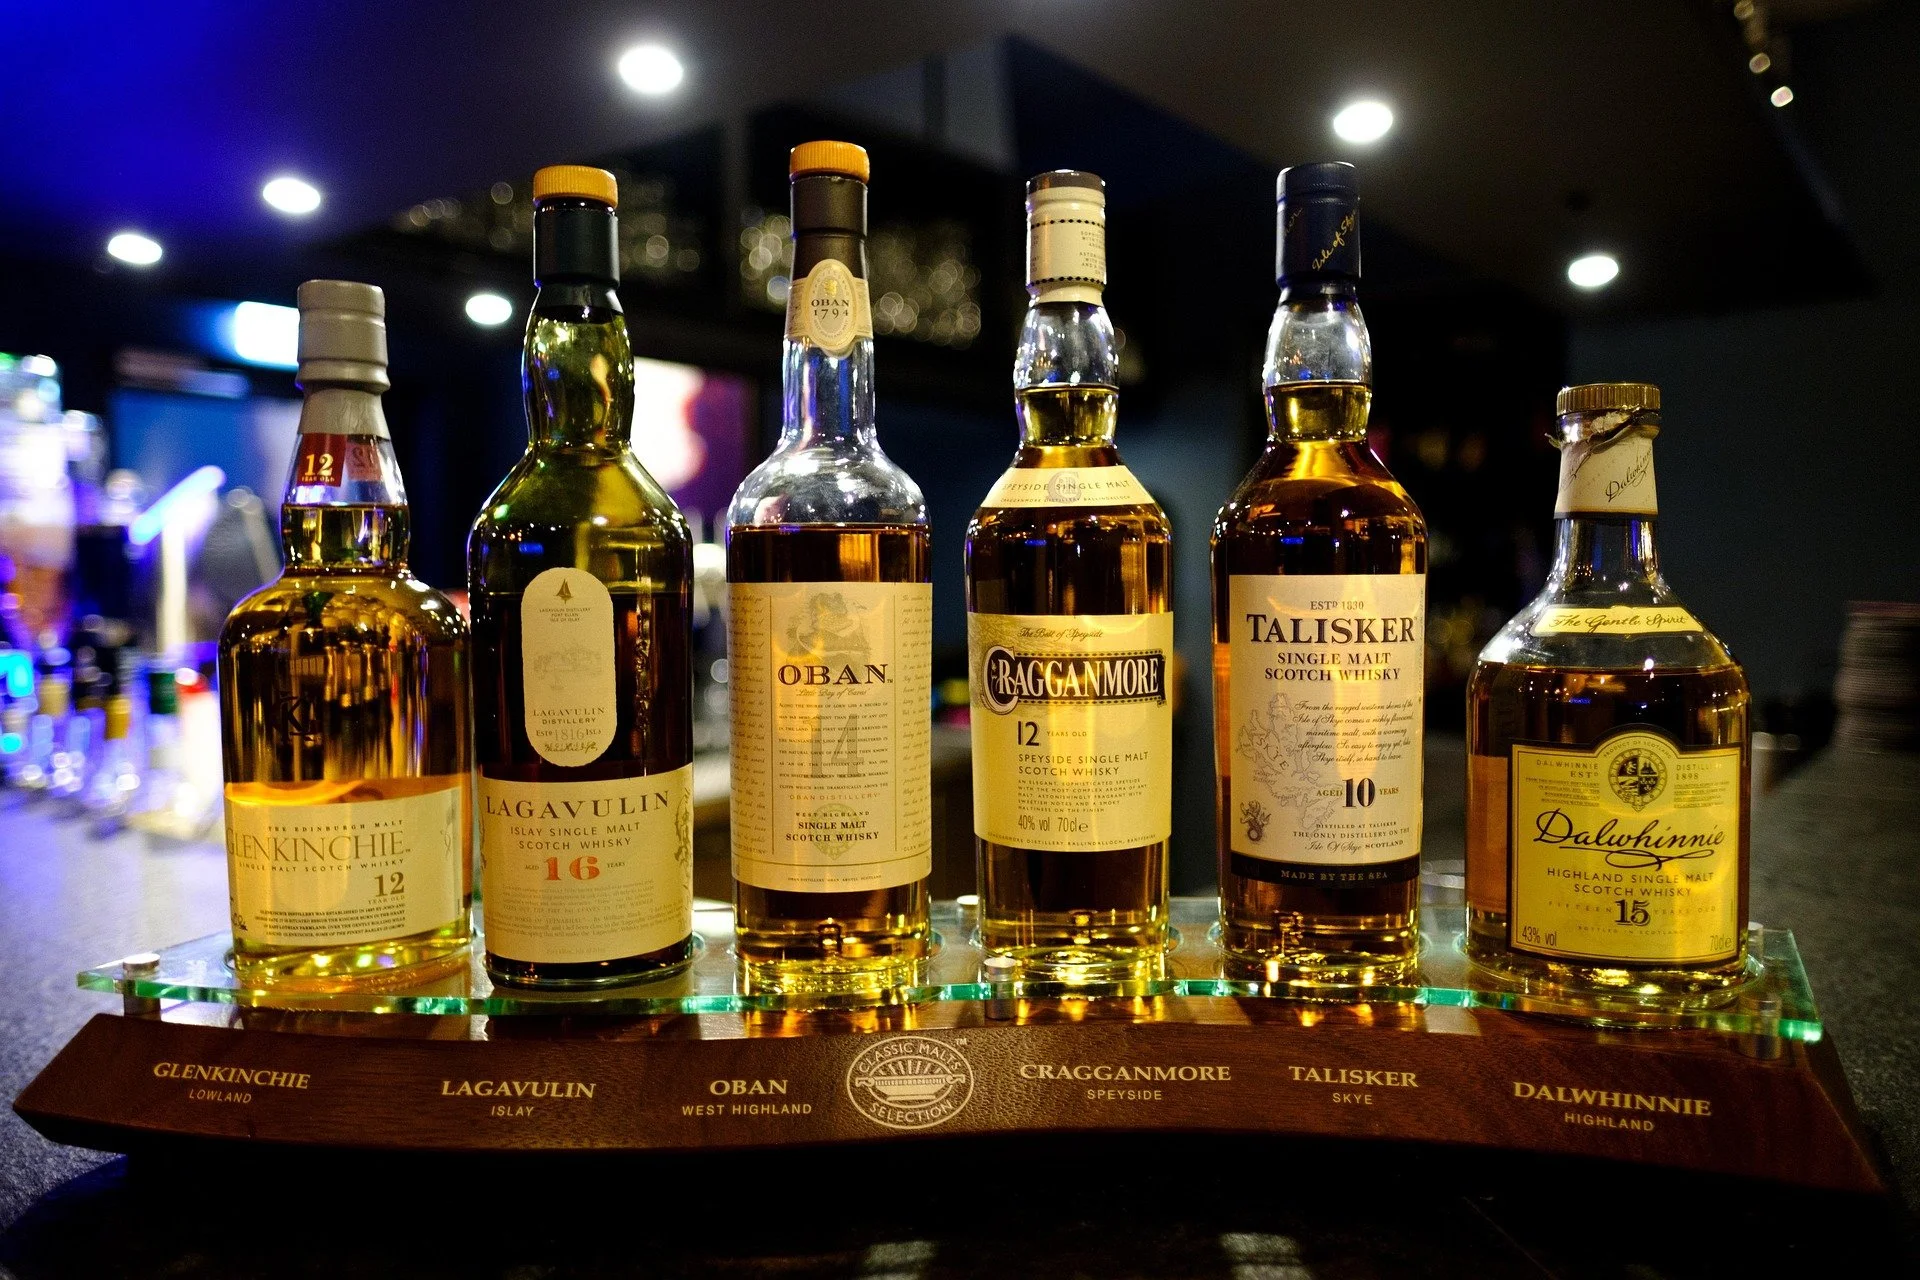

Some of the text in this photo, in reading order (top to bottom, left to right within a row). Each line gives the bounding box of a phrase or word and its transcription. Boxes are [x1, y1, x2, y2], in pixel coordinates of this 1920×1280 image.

[811, 299, 849, 307] OBAN
[814, 309, 848, 319] 1794
[305, 453, 334, 476] 12
[1002, 480, 1130, 491] SPEYSIDE SINGLE MALT
[1342, 600, 1364, 610] 1830
[1247, 613, 1415, 644] TALISKER
[1549, 614, 1687, 633] The Gentle Spirit
[1018, 627, 1104, 642] The Best of Speyside
[1277, 652, 1392, 665] SINGLE MALT
[777, 663, 888, 686] OBAN
[983, 645, 1159, 715] CRAGGANMORE
[1265, 667, 1400, 681] SCOTCH WHISKY
[533, 707, 605, 717] LAGAVULIN
[1294, 701, 1320, 711] From
[1321, 703, 1333, 711] the
[1335, 702, 1361, 714] rugged
[542, 717, 596, 725] DISTILLERY
[1017, 720, 1040, 746] 12
[1047, 730, 1088, 738] YEARS OLD
[1306, 729, 1340, 737] maritime
[1362, 728, 1377, 736] with
[1018, 751, 1149, 764] SPEYSIDE SINGLE MALT
[1312, 752, 1335, 765] Skye
[1536, 759, 1599, 770] DALWHINNIE
[1018, 766, 1120, 777] SCOTCH WHISKY
[1316, 777, 1400, 809] AGED 10 YEARS
[486, 790, 670, 819] LAGAVULIN
[294, 823, 366, 833] EDINBURGH
[374, 819, 404, 828] MALT
[510, 822, 641, 837] ISLAY SINGLE MALT
[798, 820, 867, 830] SINGLE MALT
[1018, 815, 1050, 832] 40% vol
[1533, 807, 1724, 851] Dalwhinnie
[786, 831, 879, 842] SCOTCH WHISKY
[1340, 830, 1387, 839] DISTILLERY
[226, 827, 405, 863] GLENKINCHIE
[519, 837, 632, 850] SCOTCH WHISKY
[1364, 839, 1404, 849] SCOTLAND
[271, 865, 297, 873] MALT
[305, 864, 352, 873] SCOTCH
[360, 858, 405, 870] WHISKY
[544, 856, 601, 881] 16
[1280, 869, 1388, 881] MADE BY THE SEA
[1547, 867, 1715, 884] HIGHLAND SINGLE MALT
[374, 871, 406, 898] 12
[1574, 883, 1692, 897] SCOTCH WHISKY
[1614, 899, 1651, 927] 15
[1521, 925, 1557, 947] 43% vol
[858, 1041, 914, 1073] CLASSIC
[918, 1042, 963, 1071] MALTS
[153, 1062, 311, 1089] GLENKINCHIE
[1019, 1064, 1232, 1082] CRAGGANMORE
[1288, 1065, 1419, 1088] TALISKER
[441, 1080, 596, 1099] LAGAVULIN
[709, 1079, 788, 1095] OBAN
[189, 1088, 252, 1104] LOWLAND
[1087, 1089, 1163, 1101] SPEYSIDE
[1332, 1092, 1374, 1105] SKYE
[1513, 1081, 1712, 1117] DALWHINNIE
[491, 1105, 535, 1117] ISLAY
[682, 1103, 812, 1116] WEST HIGHLAND
[869, 1100, 954, 1123] SELECTION
[1564, 1111, 1655, 1132] HIGHLAND
